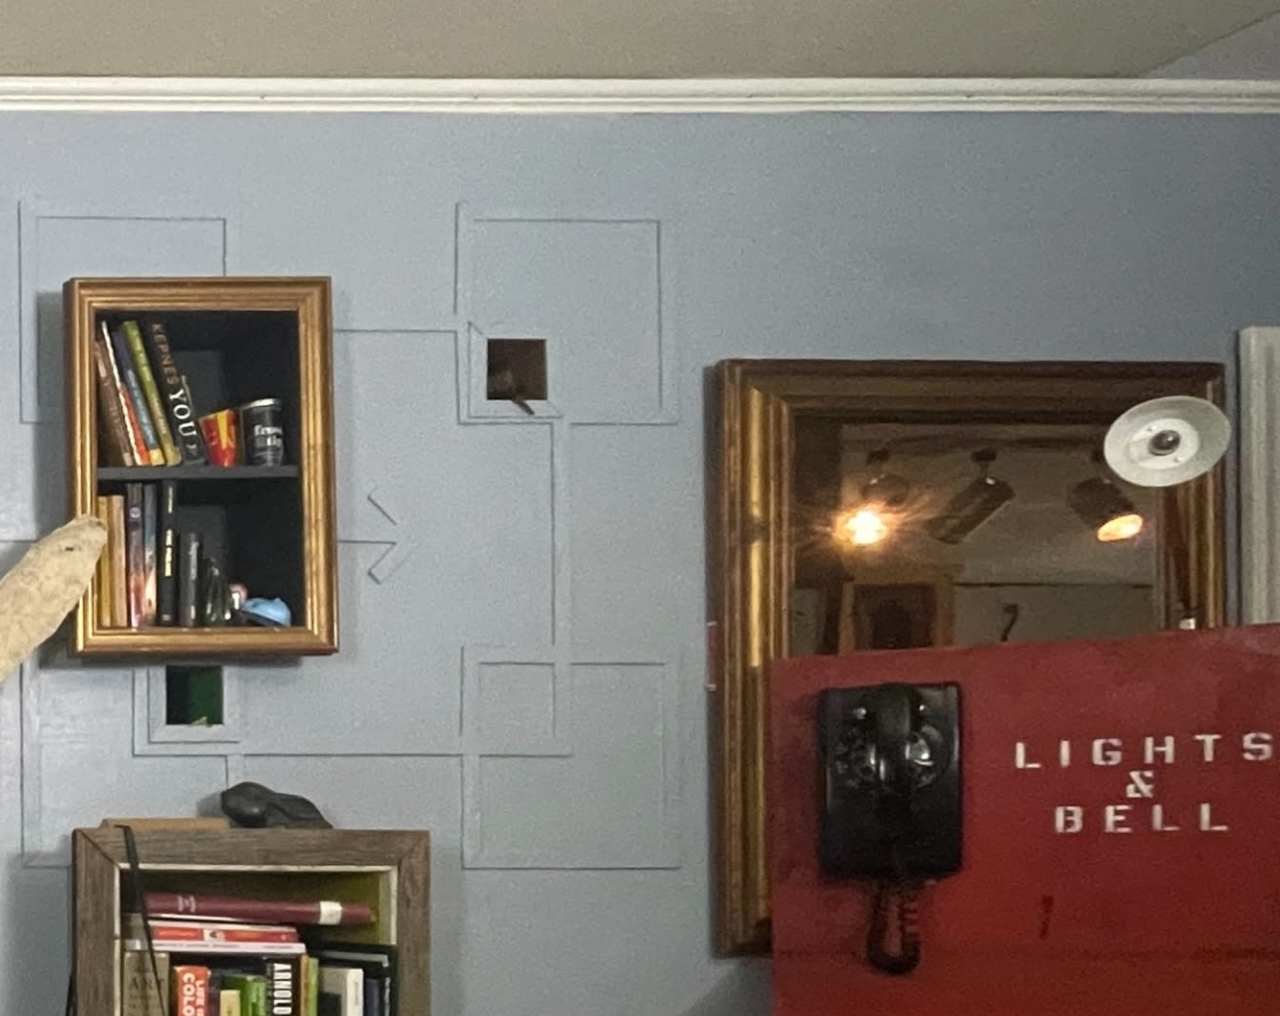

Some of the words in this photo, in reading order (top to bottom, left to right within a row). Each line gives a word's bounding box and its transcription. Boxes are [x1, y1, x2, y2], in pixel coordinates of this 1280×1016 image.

[166, 386, 199, 439] YOU
[1014, 732, 1274, 769] LIGHTS
[1125, 770, 1156, 799] &
[1054, 802, 1230, 835] BELL
[195, 980, 204, 1005] LIFE
[273, 963, 292, 1015] ARNOLD
